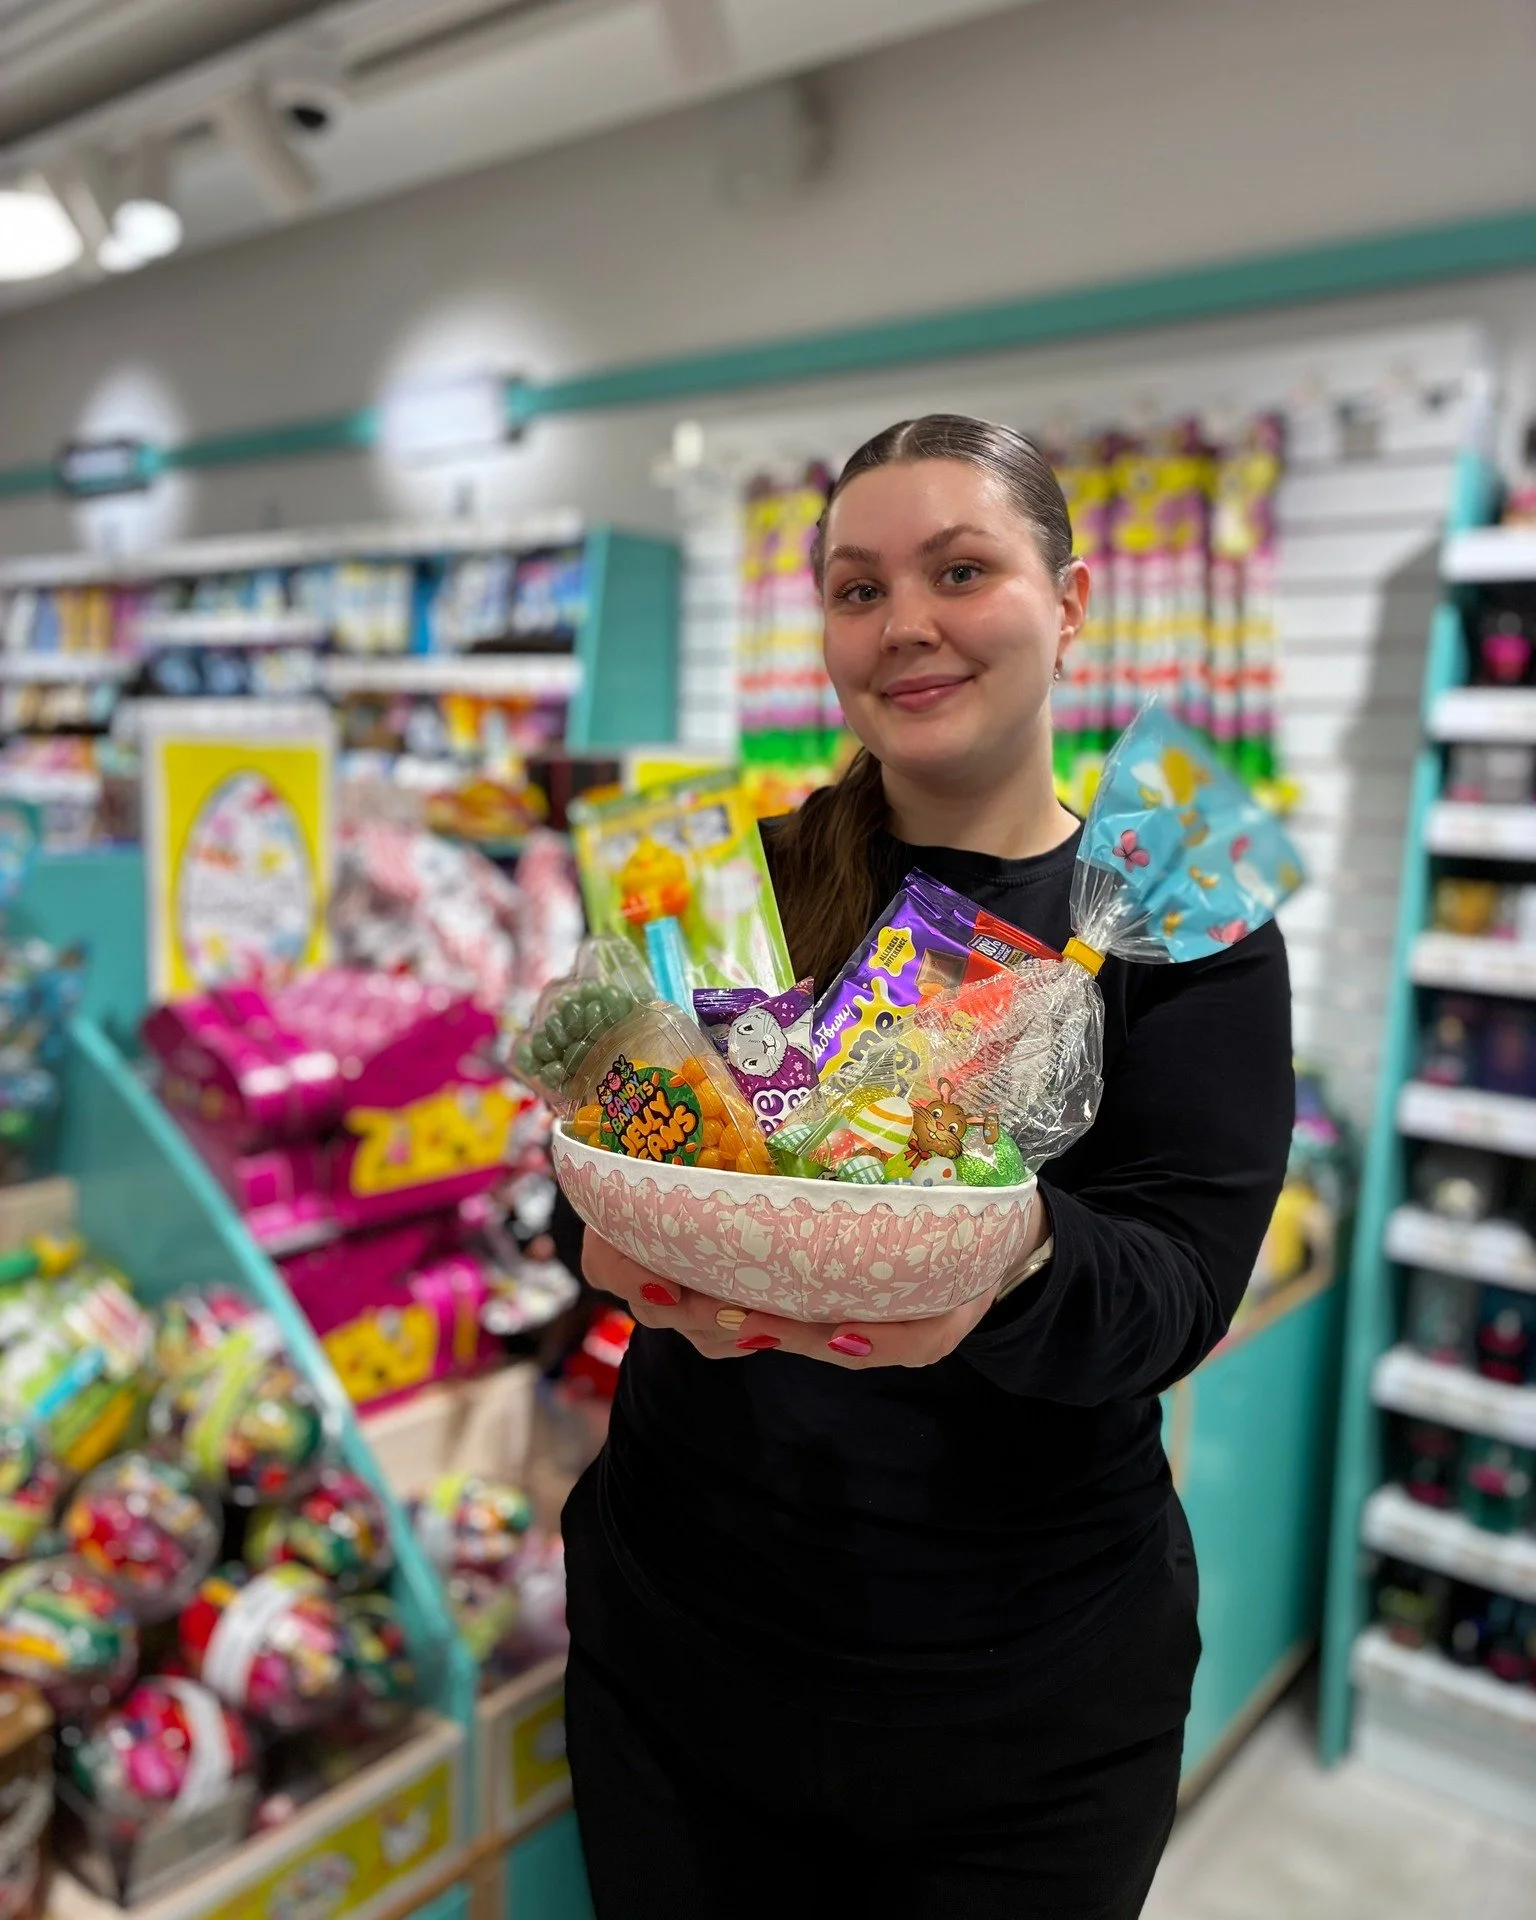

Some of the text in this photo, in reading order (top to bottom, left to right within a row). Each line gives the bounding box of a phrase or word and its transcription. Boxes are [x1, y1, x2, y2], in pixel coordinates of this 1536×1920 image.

[879, 936, 899, 961] ALLERGEN
[884, 937, 907, 967] DIFFERENCE
[607, 1073, 640, 1118] CANDY
[611, 1080, 654, 1135] BANDITS
[620, 1090, 671, 1157] JELLY
[637, 1104, 697, 1162] ANS
